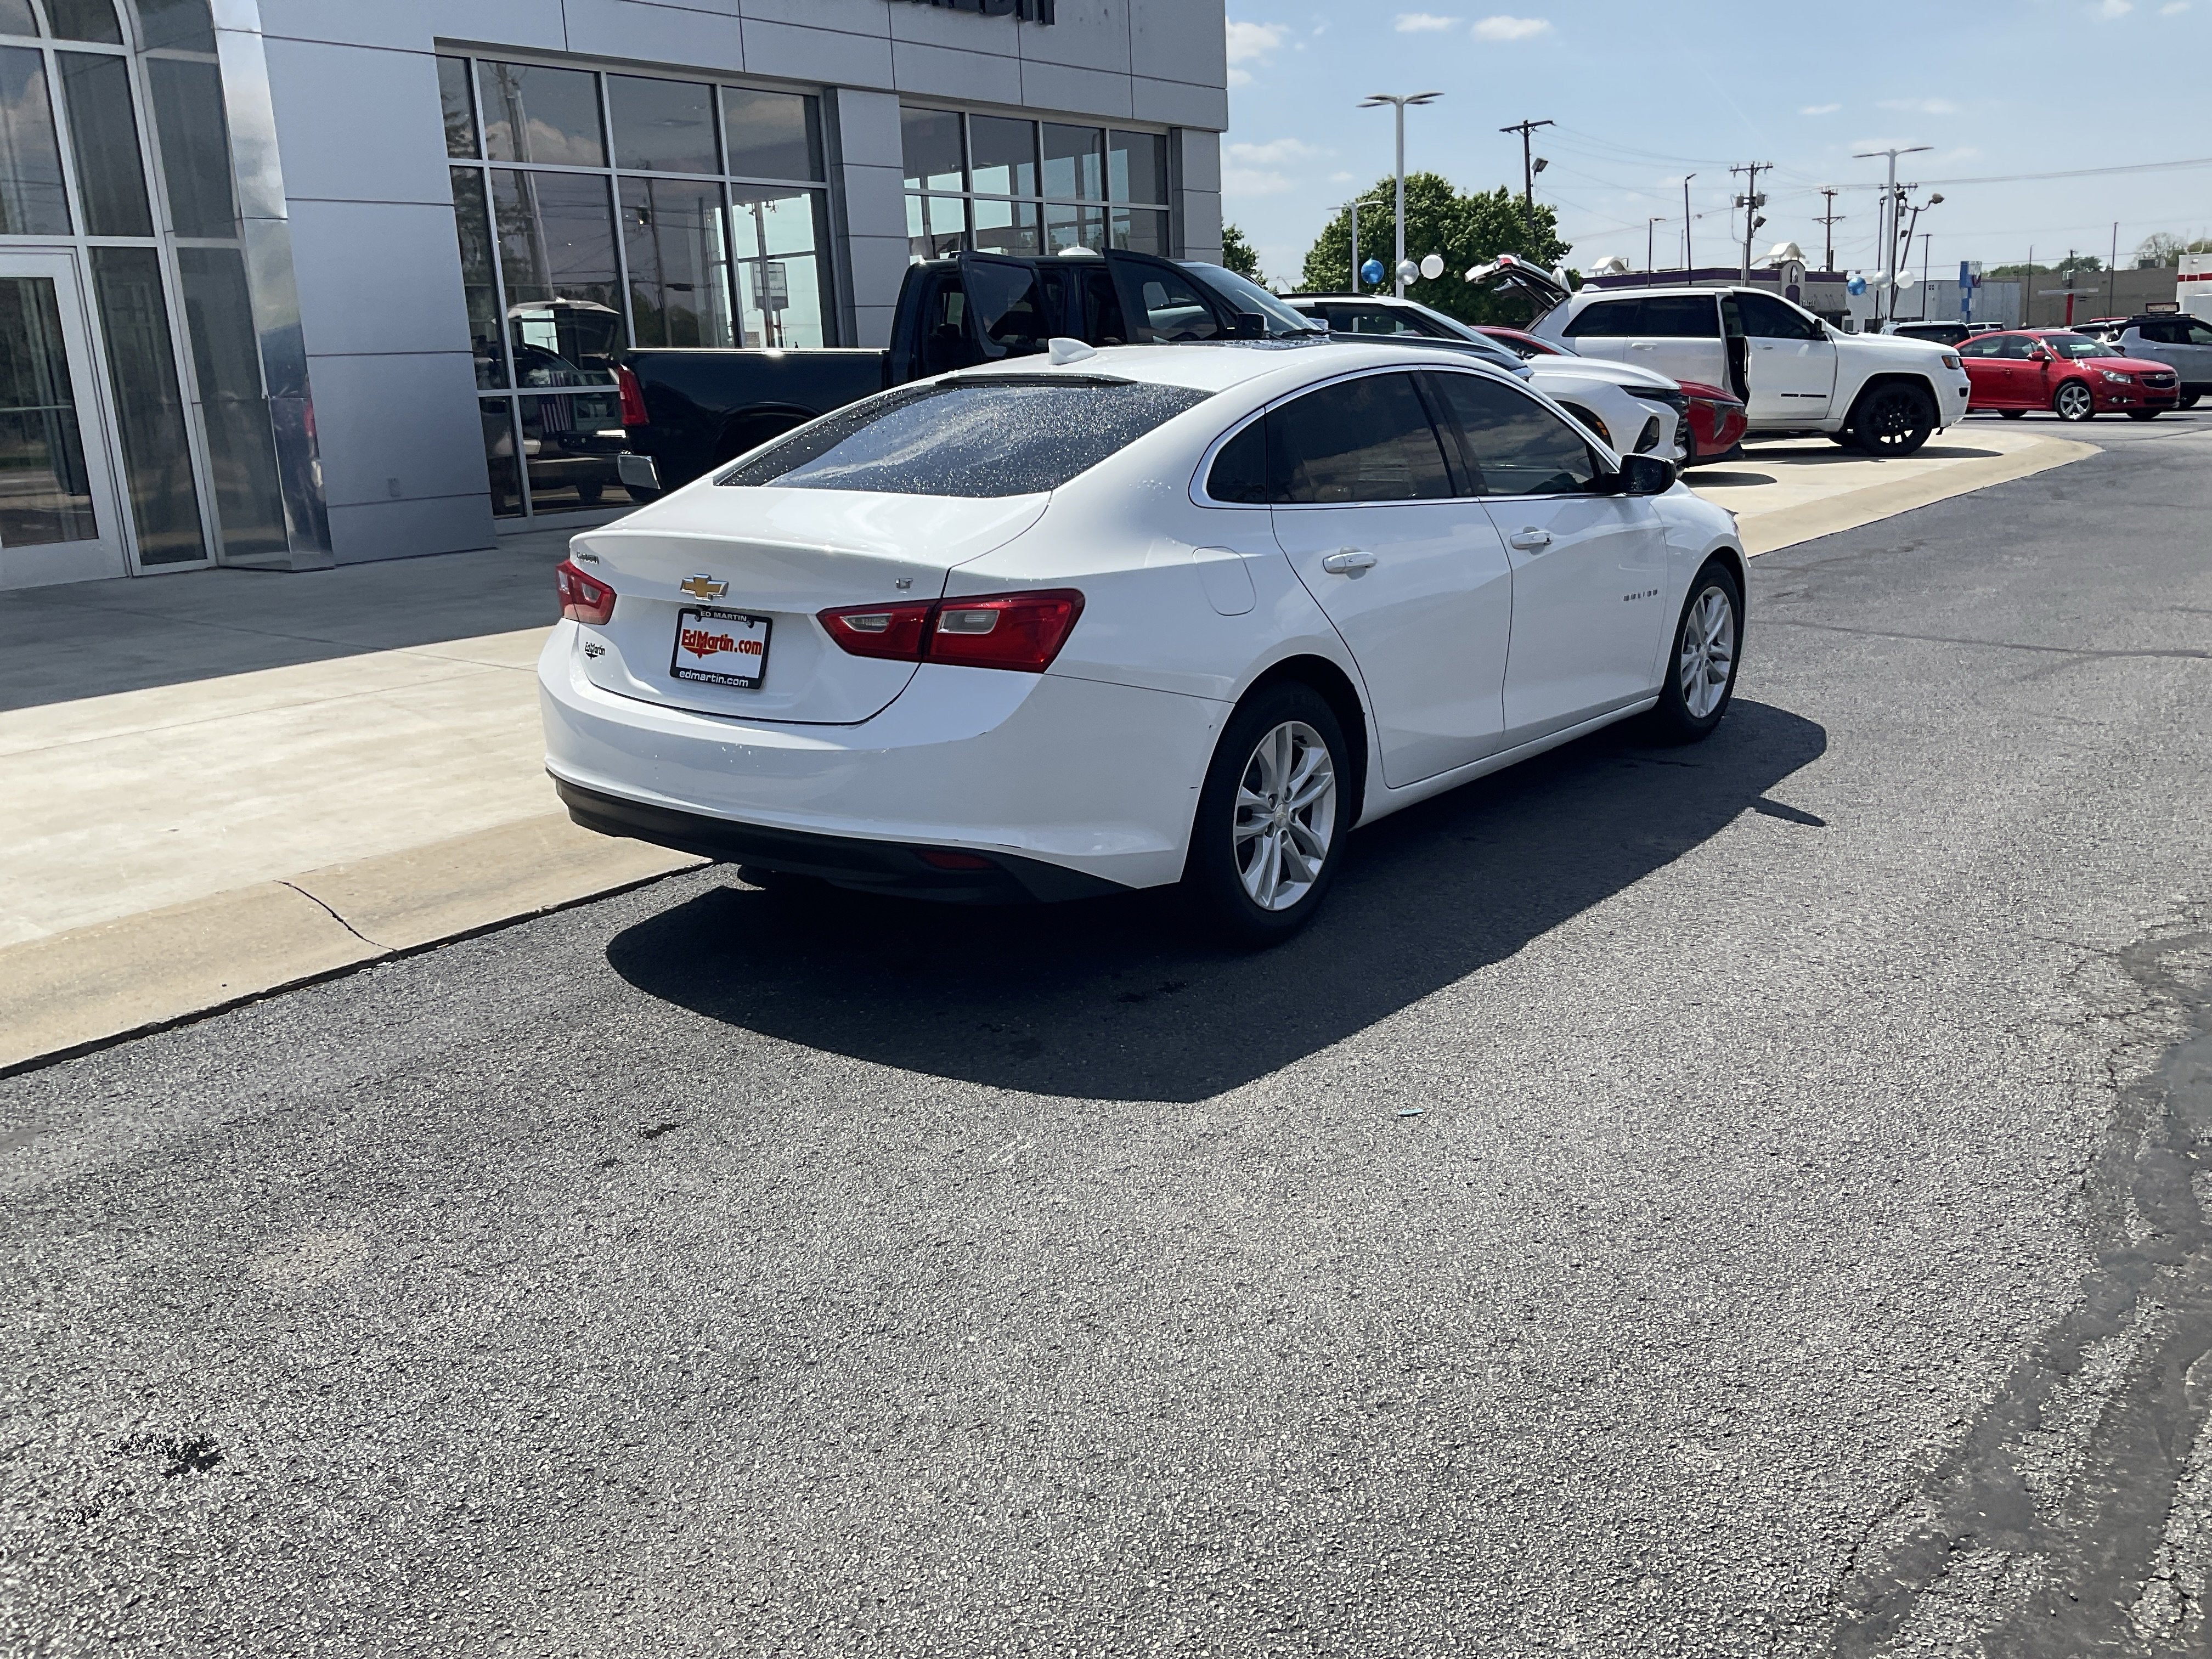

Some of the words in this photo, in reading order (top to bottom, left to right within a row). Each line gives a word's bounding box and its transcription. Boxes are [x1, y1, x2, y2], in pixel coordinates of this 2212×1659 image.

[714, 612, 747, 622] MARTIN
[681, 629, 763, 656] EdMartin.com
[679, 669, 749, 687] edmartin.com
